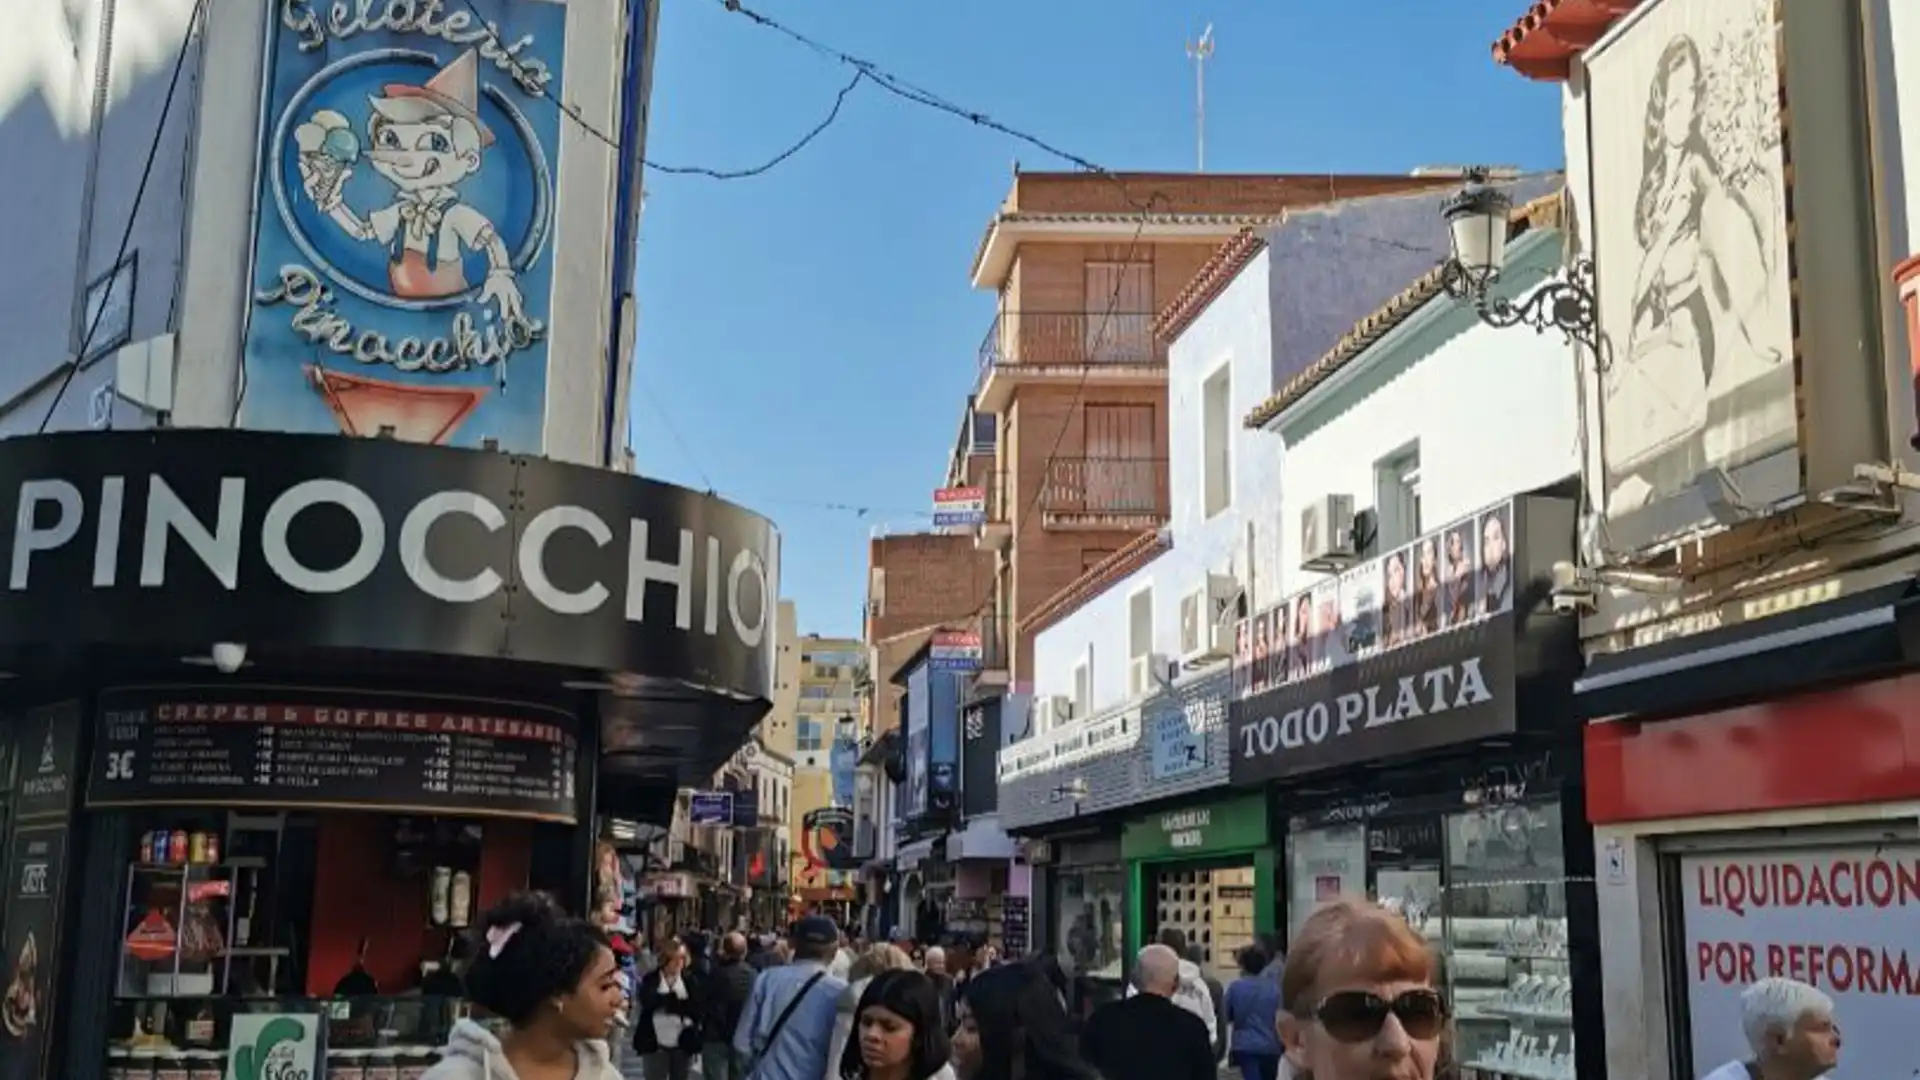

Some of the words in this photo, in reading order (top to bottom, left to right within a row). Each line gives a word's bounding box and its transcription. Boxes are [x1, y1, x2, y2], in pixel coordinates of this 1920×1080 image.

[9, 474, 767, 648] PINOCCHIO
[158, 704, 268, 721] CREPES
[315, 708, 428, 728] GOFRES
[1240, 701, 1329, 758] TODO
[1337, 656, 1492, 735] PLATA
[106, 751, 135, 779] 3€
[1698, 848, 1920, 917] LIQUIDACIÓN
[1698, 941, 1758, 984] POR
[1768, 944, 1920, 995] REFORM
